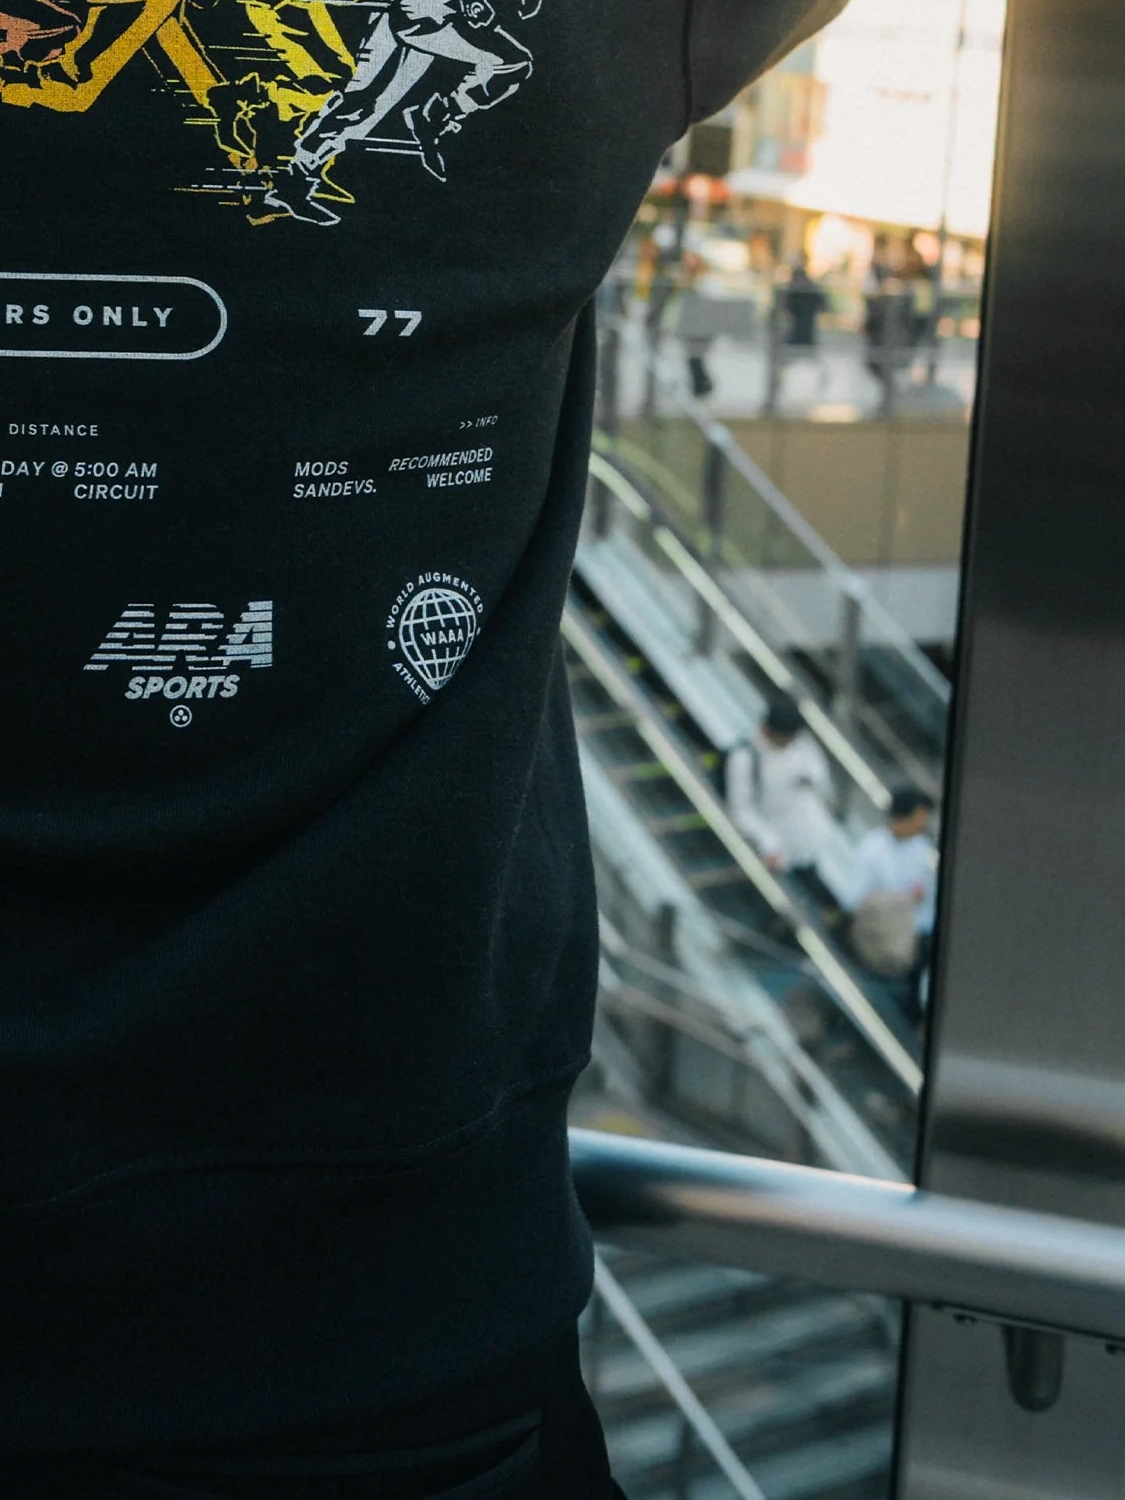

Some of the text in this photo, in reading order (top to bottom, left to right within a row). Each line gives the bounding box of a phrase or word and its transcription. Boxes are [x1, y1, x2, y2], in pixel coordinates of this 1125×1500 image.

[73, 304, 174, 329] ONLY
[357, 308, 423, 337] 77
[9, 423, 100, 437] DISTANCE
[51, 461, 69, 478] @
[74, 462, 119, 478] 5:00
[125, 462, 158, 478] AM
[294, 447, 494, 477] MODS RECOMMENDED
[74, 484, 159, 500] CIRCUIT
[293, 467, 493, 499] SANDEVS. WELCOME
[386, 571, 484, 628] WORLD AUGMENTED
[420, 628, 465, 646] WAAA
[124, 674, 241, 700] SPORTS
